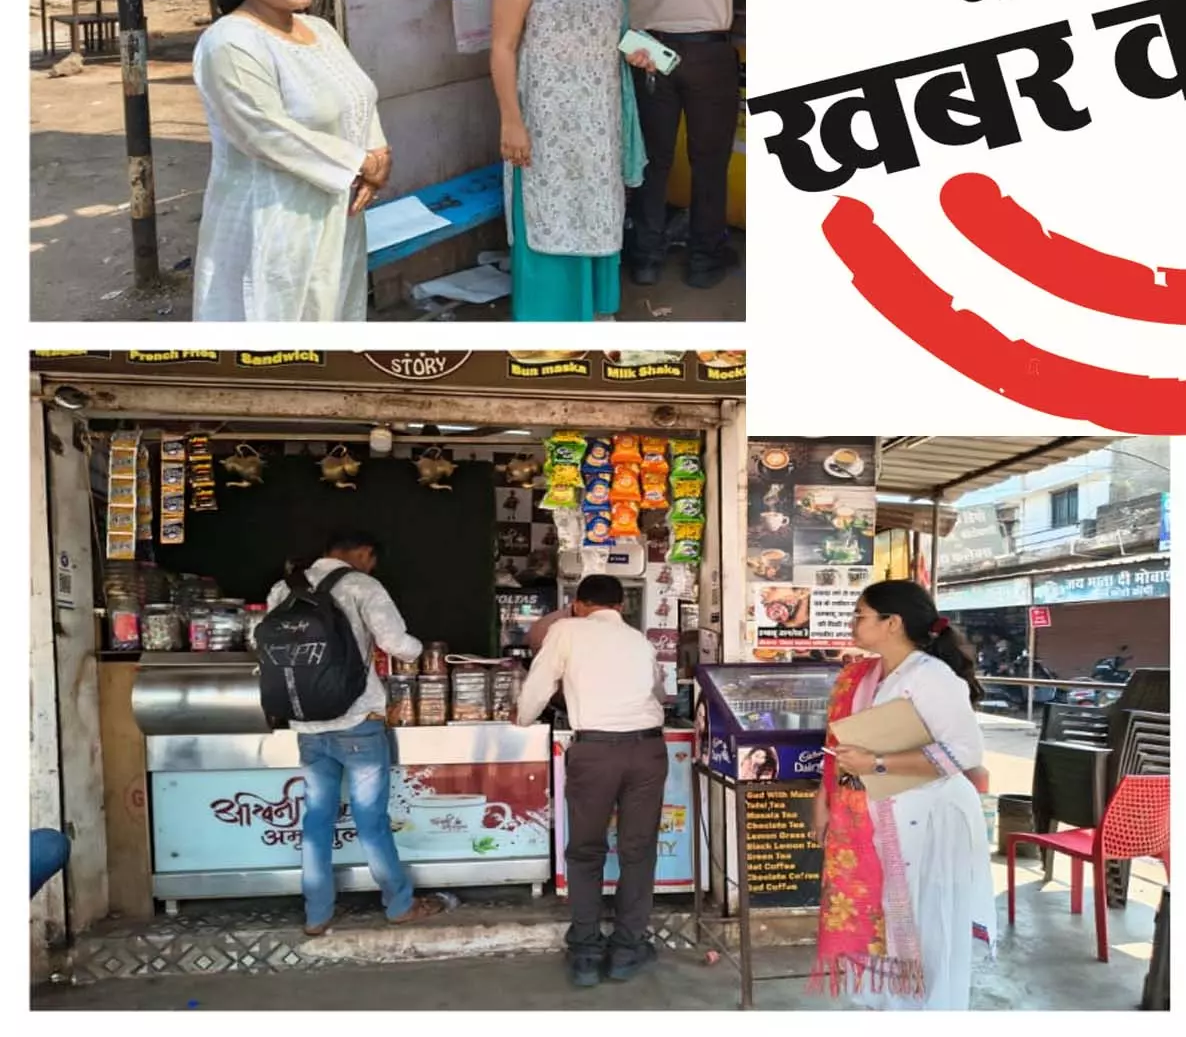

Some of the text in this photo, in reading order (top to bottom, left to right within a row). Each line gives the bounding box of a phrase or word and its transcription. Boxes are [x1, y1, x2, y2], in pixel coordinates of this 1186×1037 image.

[241, 350, 320, 365] Sandwich
[390, 357, 447, 376] STORY
[511, 363, 587, 377] Bun maska
[607, 364, 681, 379] Milk Shake
